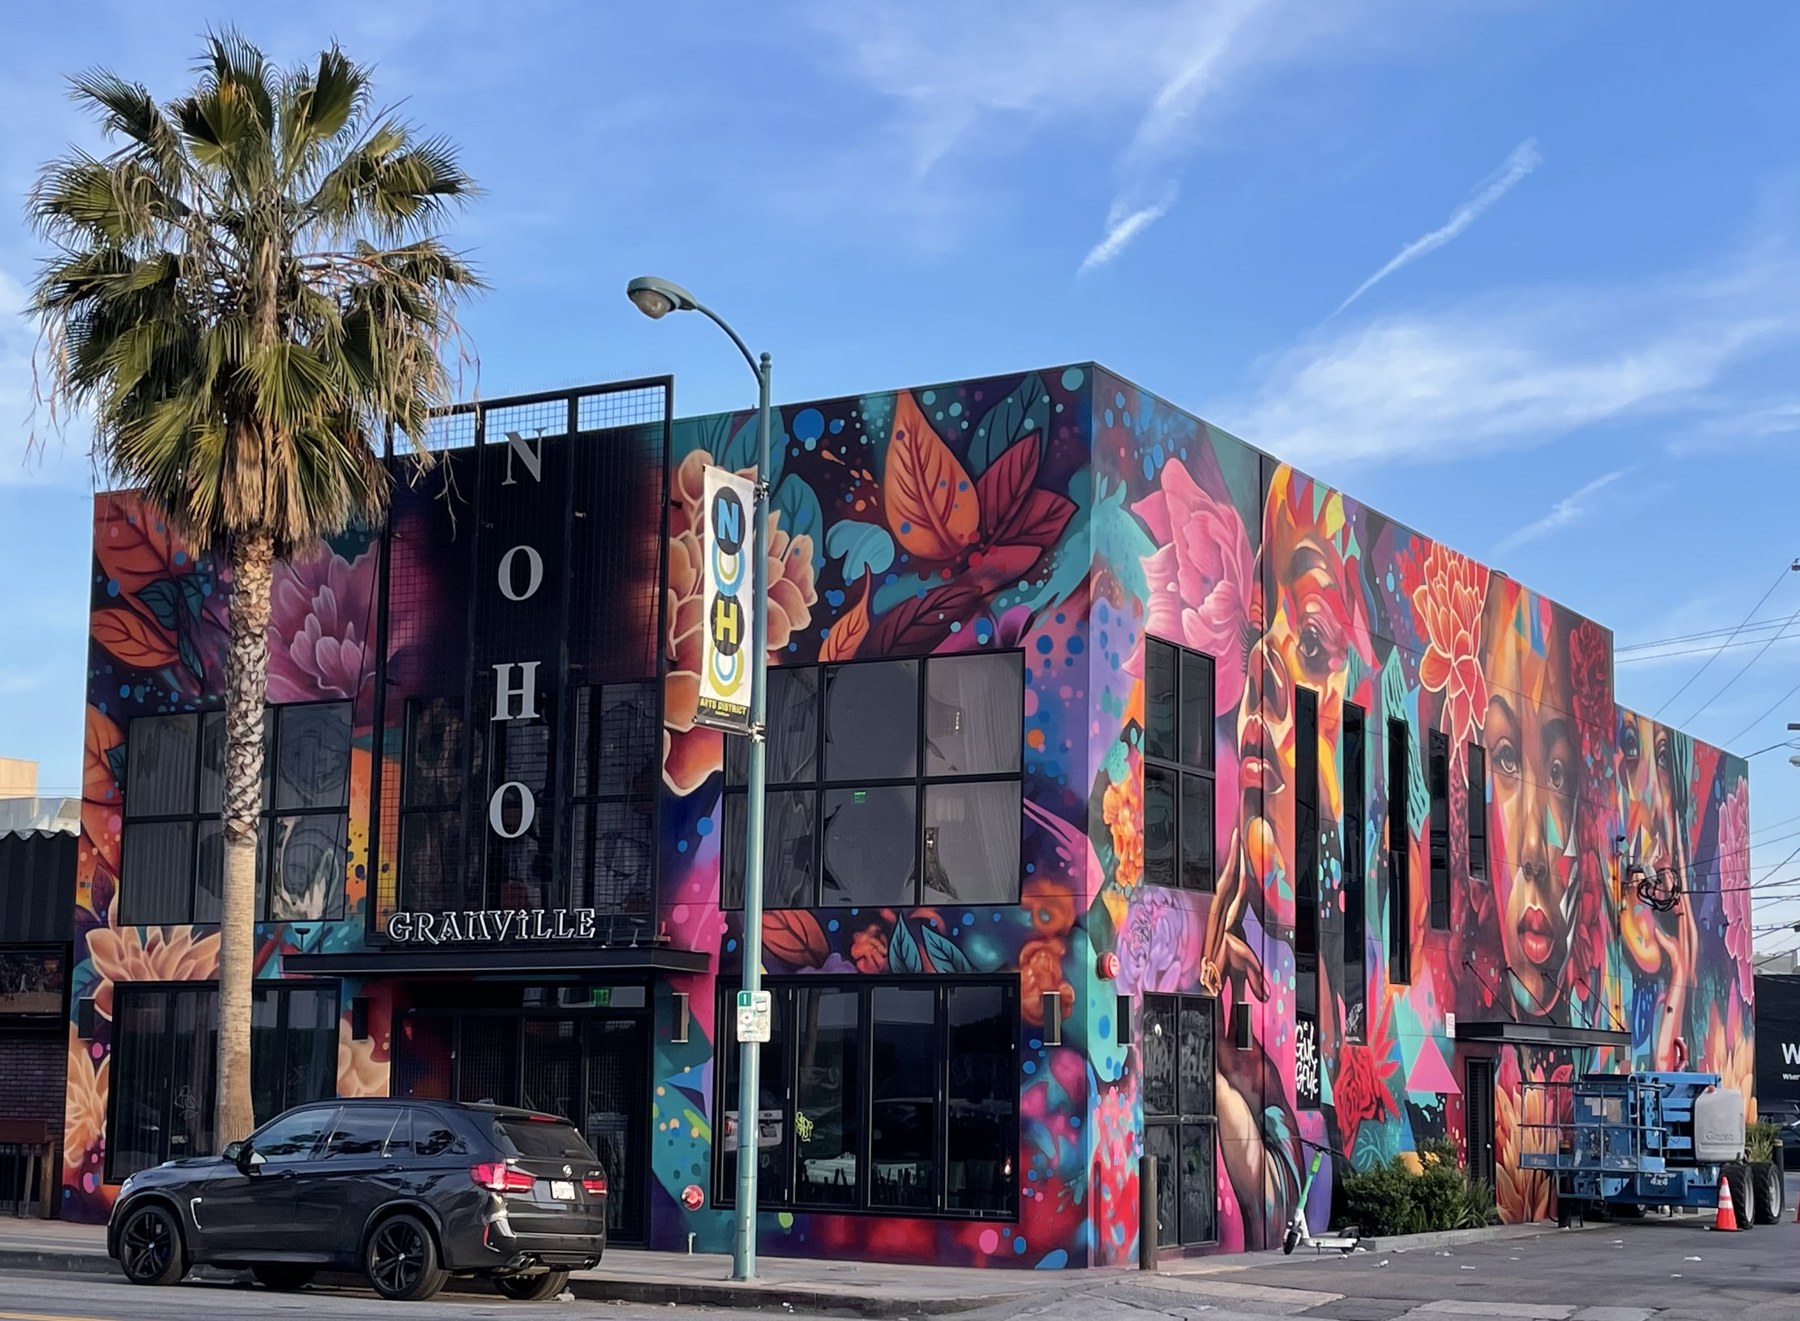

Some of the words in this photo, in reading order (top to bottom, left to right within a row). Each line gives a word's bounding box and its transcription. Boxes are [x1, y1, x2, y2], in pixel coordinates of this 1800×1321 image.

[490, 427, 547, 838] NOHO
[708, 495, 746, 697] NOHO
[700, 698, 717, 710] ARTS
[717, 701, 747, 716] DISTRICT
[1650, 1177, 1668, 1186] 4x4
